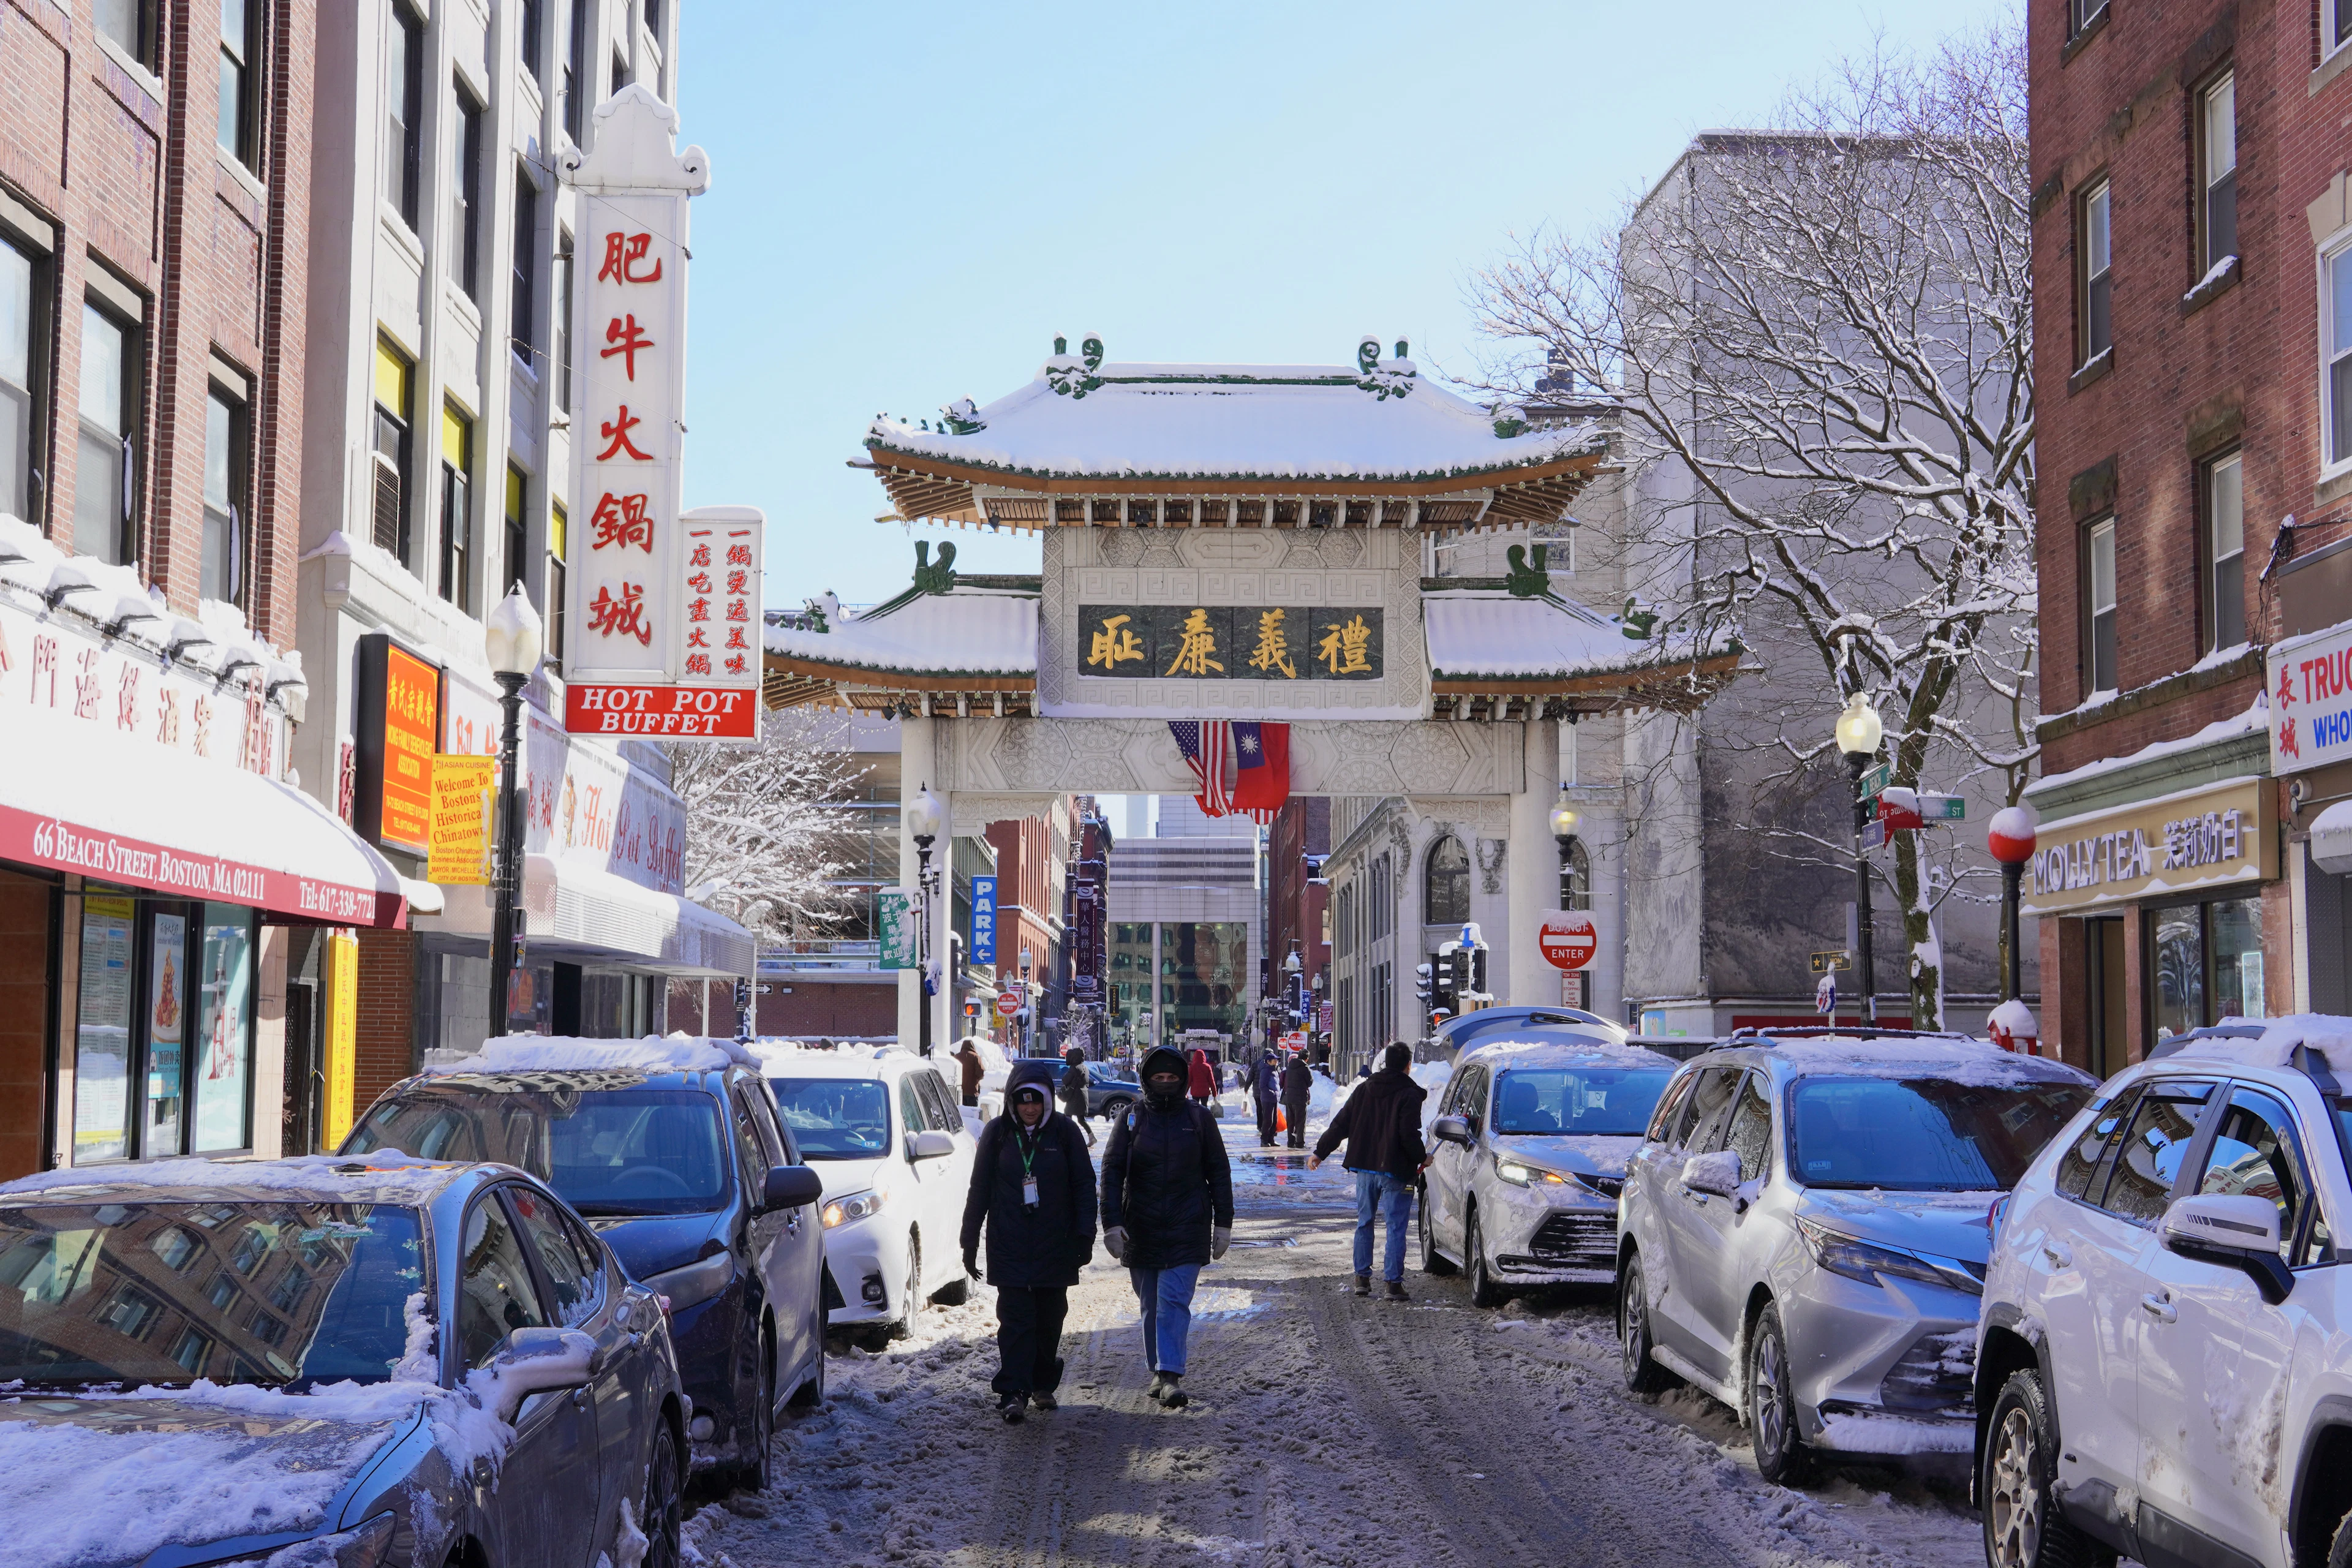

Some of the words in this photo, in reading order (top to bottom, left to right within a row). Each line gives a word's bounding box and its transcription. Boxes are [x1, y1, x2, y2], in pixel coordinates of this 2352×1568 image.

[588, 232, 662, 648] 肥牛火鍋城
[581, 688, 654, 711] HOT
[672, 690, 741, 713] POT
[600, 712, 721, 734] BUFFET
[2313, 709, 2352, 748] WHO
[387, 724, 399, 745] WONG
[399, 728, 411, 753] FAMILY
[411, 734, 432, 761] BENEVOLENT
[398, 754, 420, 780] ASSOCIATION
[435, 778, 475, 794] Welcome
[477, 772, 488, 786] To
[1869, 772, 1882, 793] BEACH
[441, 791, 481, 809] Boston's
[1952, 807, 1961, 816] ST
[1880, 809, 1889, 819] To
[456, 846, 483, 855] Chinatown
[582, 784, 611, 853] Hot
[616, 799, 641, 865] Pot
[647, 815, 682, 892] Buffet
[2162, 809, 2243, 870] 茉莉奶白
[34, 821, 53, 858] 66
[55, 826, 105, 869] BEACH
[107, 838, 157, 885] STREET,
[159, 851, 211, 895] BOSTON,
[233, 867, 264, 900] 02111
[2034, 837, 2100, 896] MOLLY
[2101, 828, 2150, 883] TEA
[319, 884, 376, 919] 617-338-7721
[975, 881, 992, 945] PARK
[1080, 902, 1090, 973] 華人醫務中心
[1548, 923, 1561, 932] DO
[1568, 923, 1586, 932] NOT
[1552, 949, 1584, 959] ENTER
